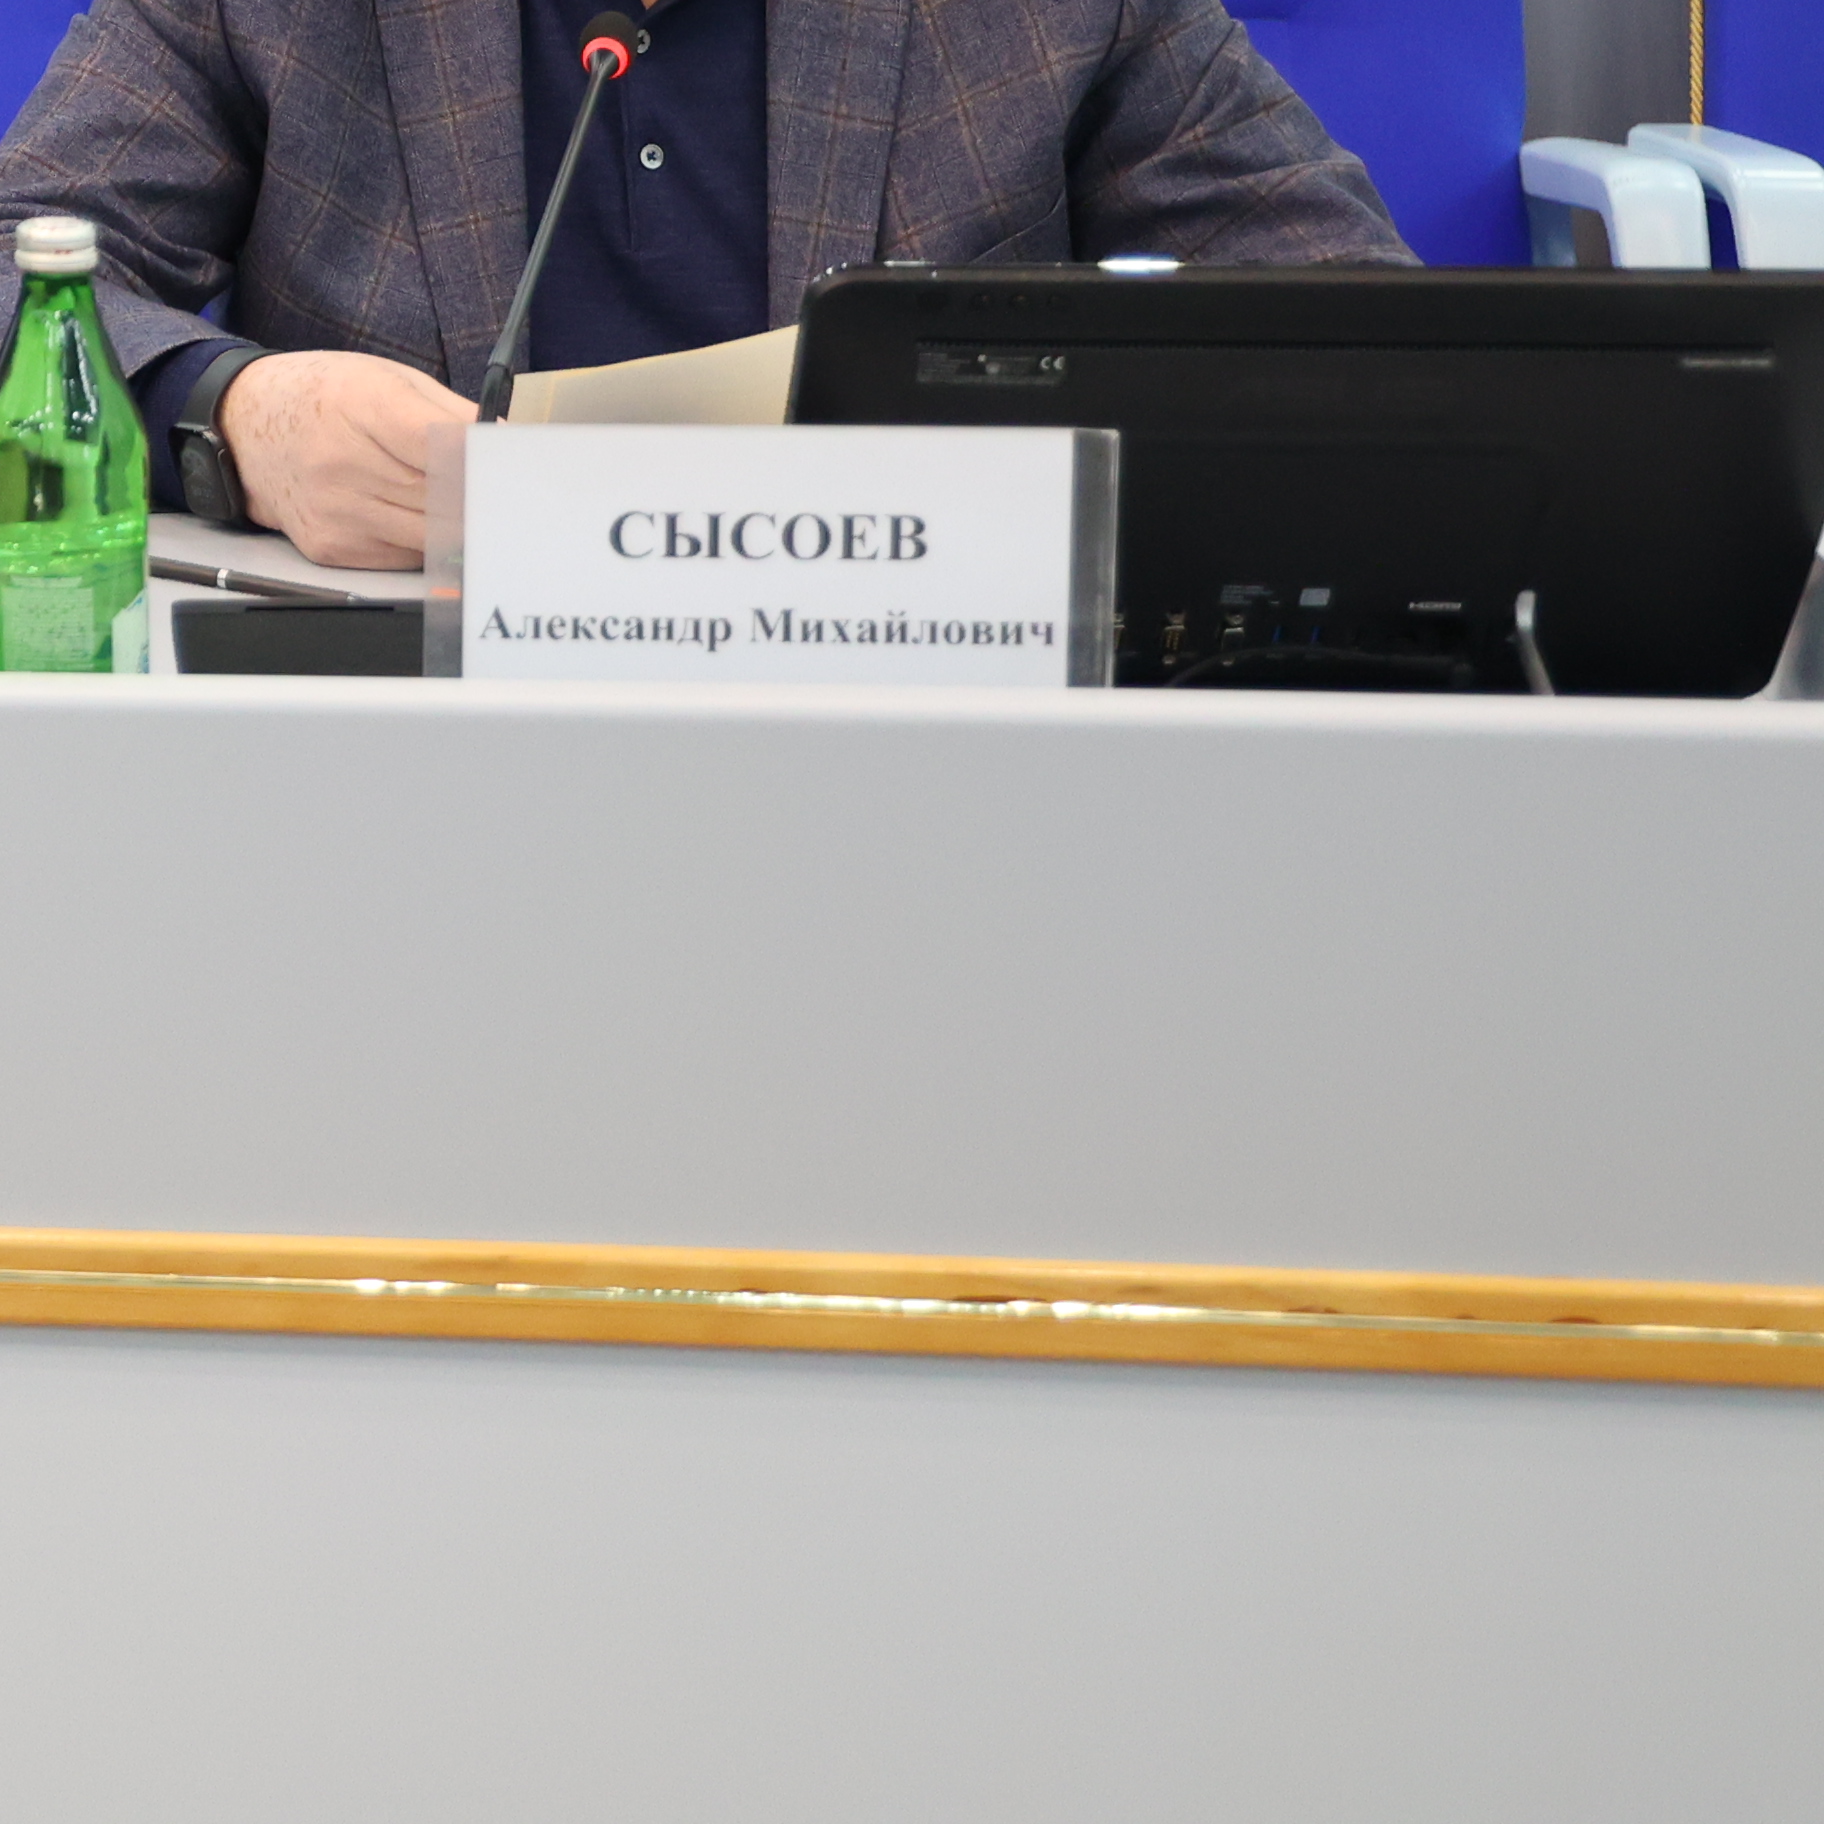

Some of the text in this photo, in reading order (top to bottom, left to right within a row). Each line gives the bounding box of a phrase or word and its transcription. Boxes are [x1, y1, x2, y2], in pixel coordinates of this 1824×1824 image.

[608, 510, 929, 562] СЫСОЕВ
[479, 606, 1056, 653] Александр Михайлович
